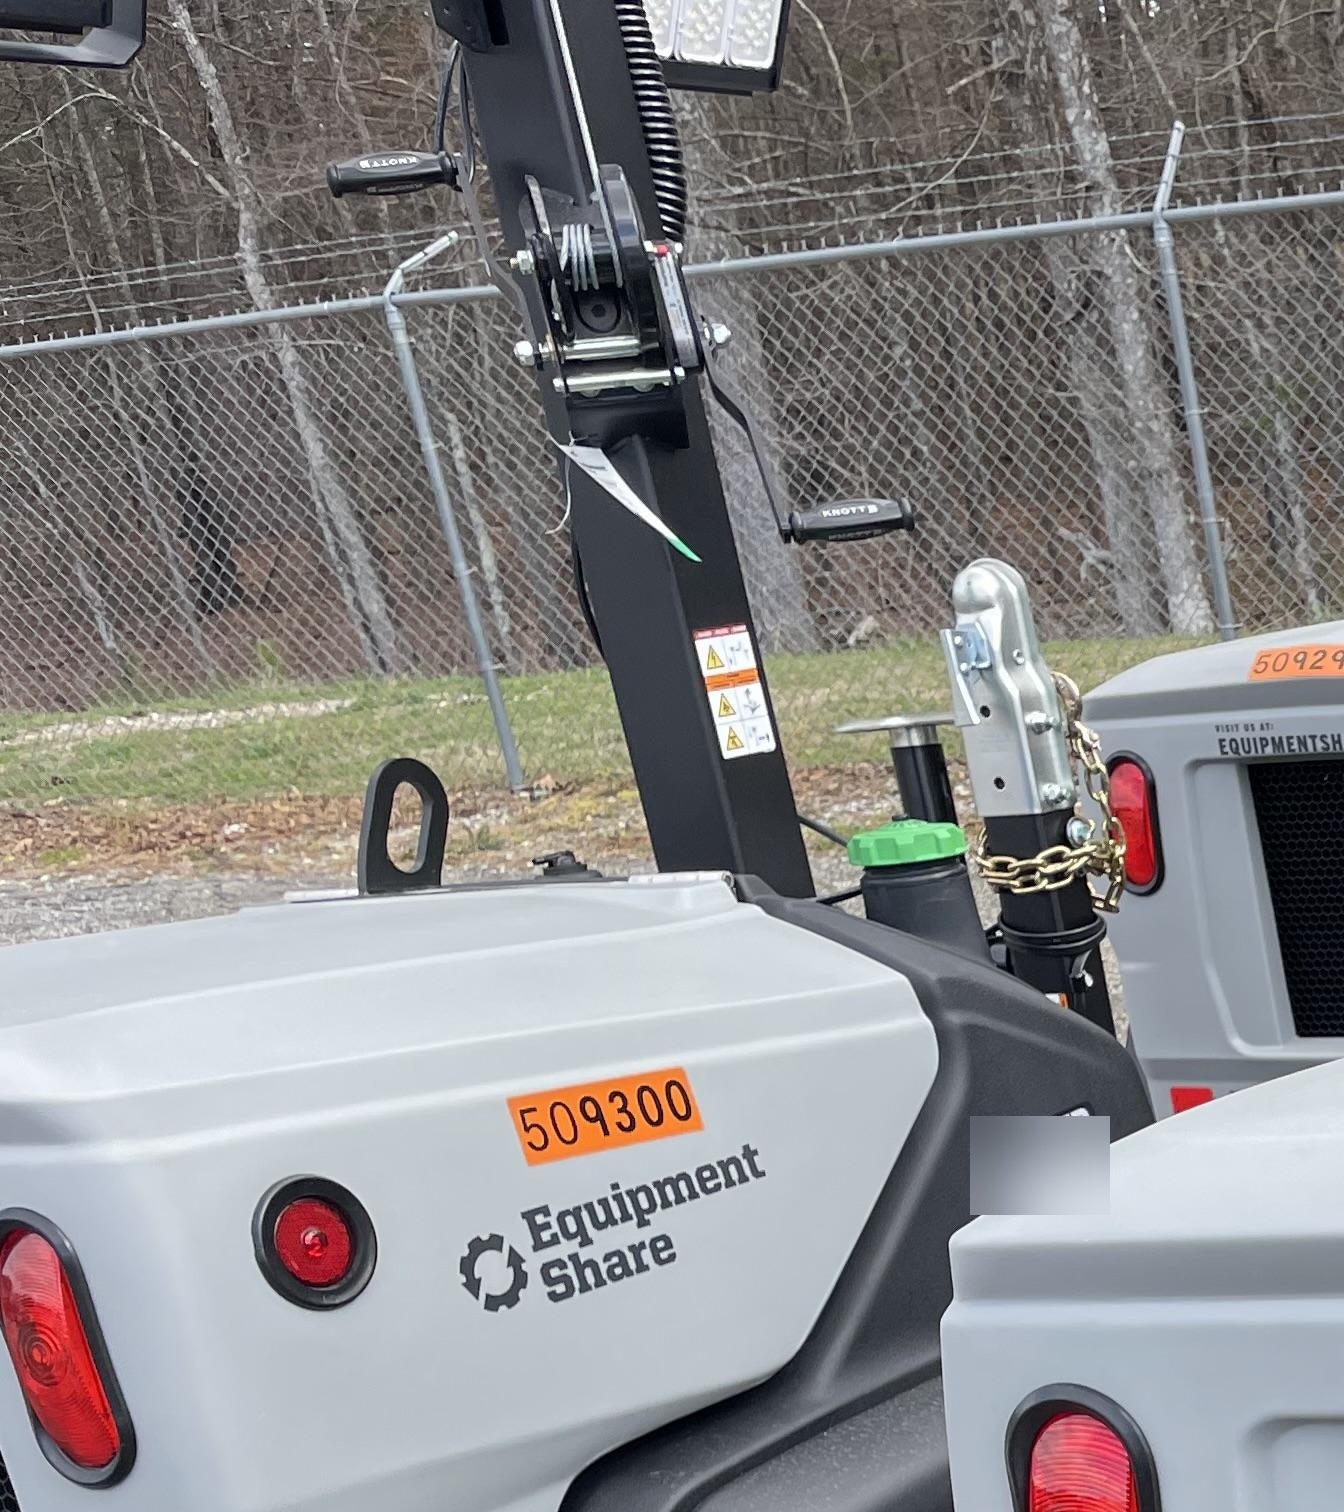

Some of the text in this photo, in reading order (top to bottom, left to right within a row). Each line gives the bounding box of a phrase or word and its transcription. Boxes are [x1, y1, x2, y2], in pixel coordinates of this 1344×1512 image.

[822, 504, 866, 518] KNOTT
[1214, 721, 1275, 733] VISIT US AT:
[518, 1079, 693, 1152] 509300
[520, 1143, 767, 1252] Equipment
[539, 1232, 677, 1303] Share
